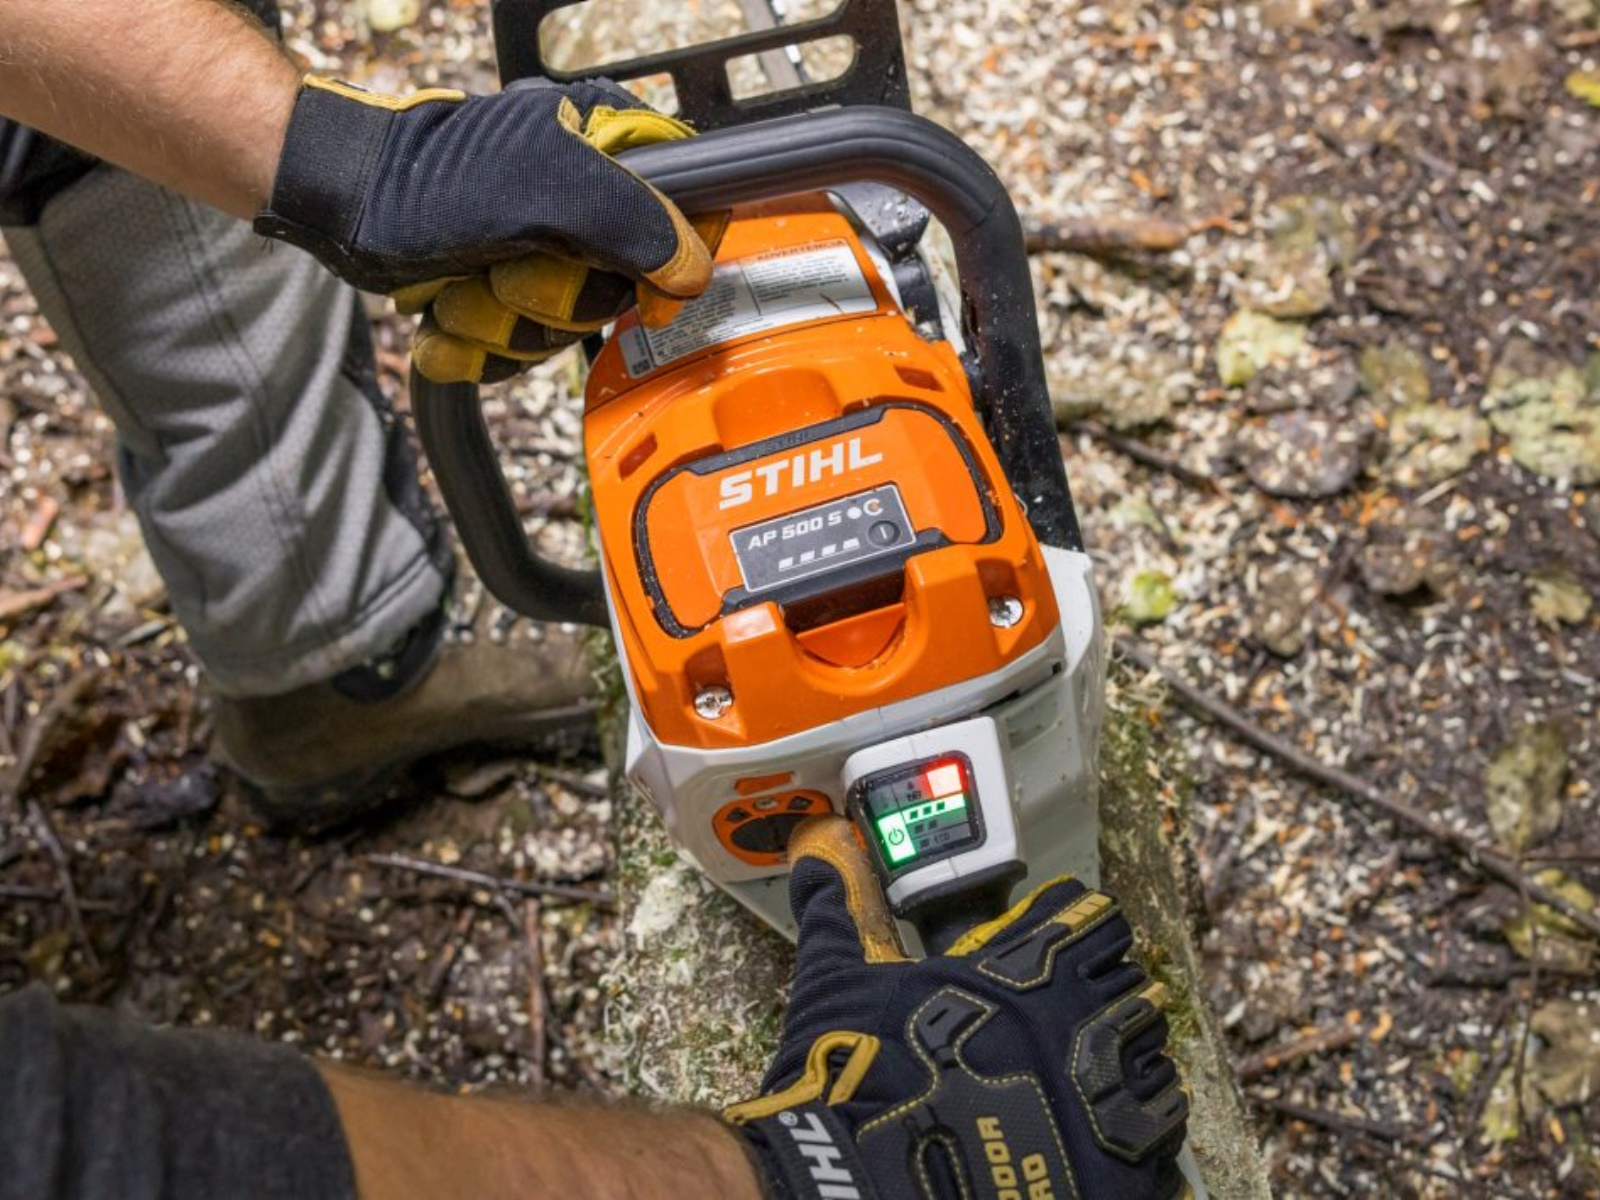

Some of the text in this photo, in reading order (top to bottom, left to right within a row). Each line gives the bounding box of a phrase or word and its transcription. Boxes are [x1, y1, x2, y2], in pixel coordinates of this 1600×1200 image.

[719, 437, 883, 511] STIHL
[748, 529, 777, 550] AP
[781, 516, 824, 540] 500
[789, 1112, 861, 1200] IHL
